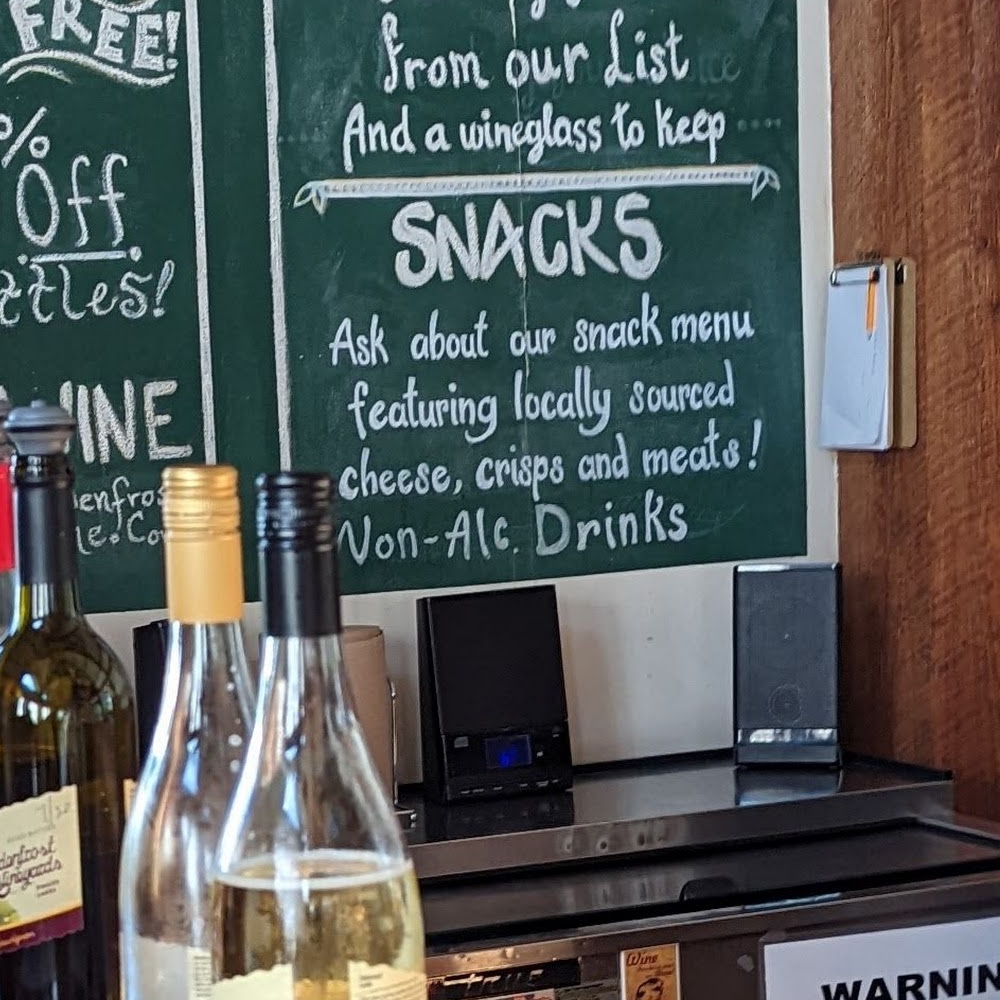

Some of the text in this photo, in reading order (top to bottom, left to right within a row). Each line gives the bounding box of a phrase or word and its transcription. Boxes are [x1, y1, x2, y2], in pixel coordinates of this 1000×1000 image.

[505, 44, 592, 90] our
[604, 9, 690, 87] List
[343, 102, 417, 174] And
[424, 124, 452, 153] a
[459, 101, 603, 165] wineglass
[611, 100, 646, 150] to
[390, 191, 663, 289] SNACKS
[329, 292, 755, 368] Ask about our snack menu
[347, 359, 735, 444] featuring locally sourced
[338, 447, 464, 501] cheese,
[475, 449, 565, 501] crisps
[577, 431, 630, 481] and
[72, 475, 170, 532] enfros
[534, 489, 690, 558] Drinks
[627, 951, 659, 967] Wine
[820, 963, 1000, 1000] WARNIN
